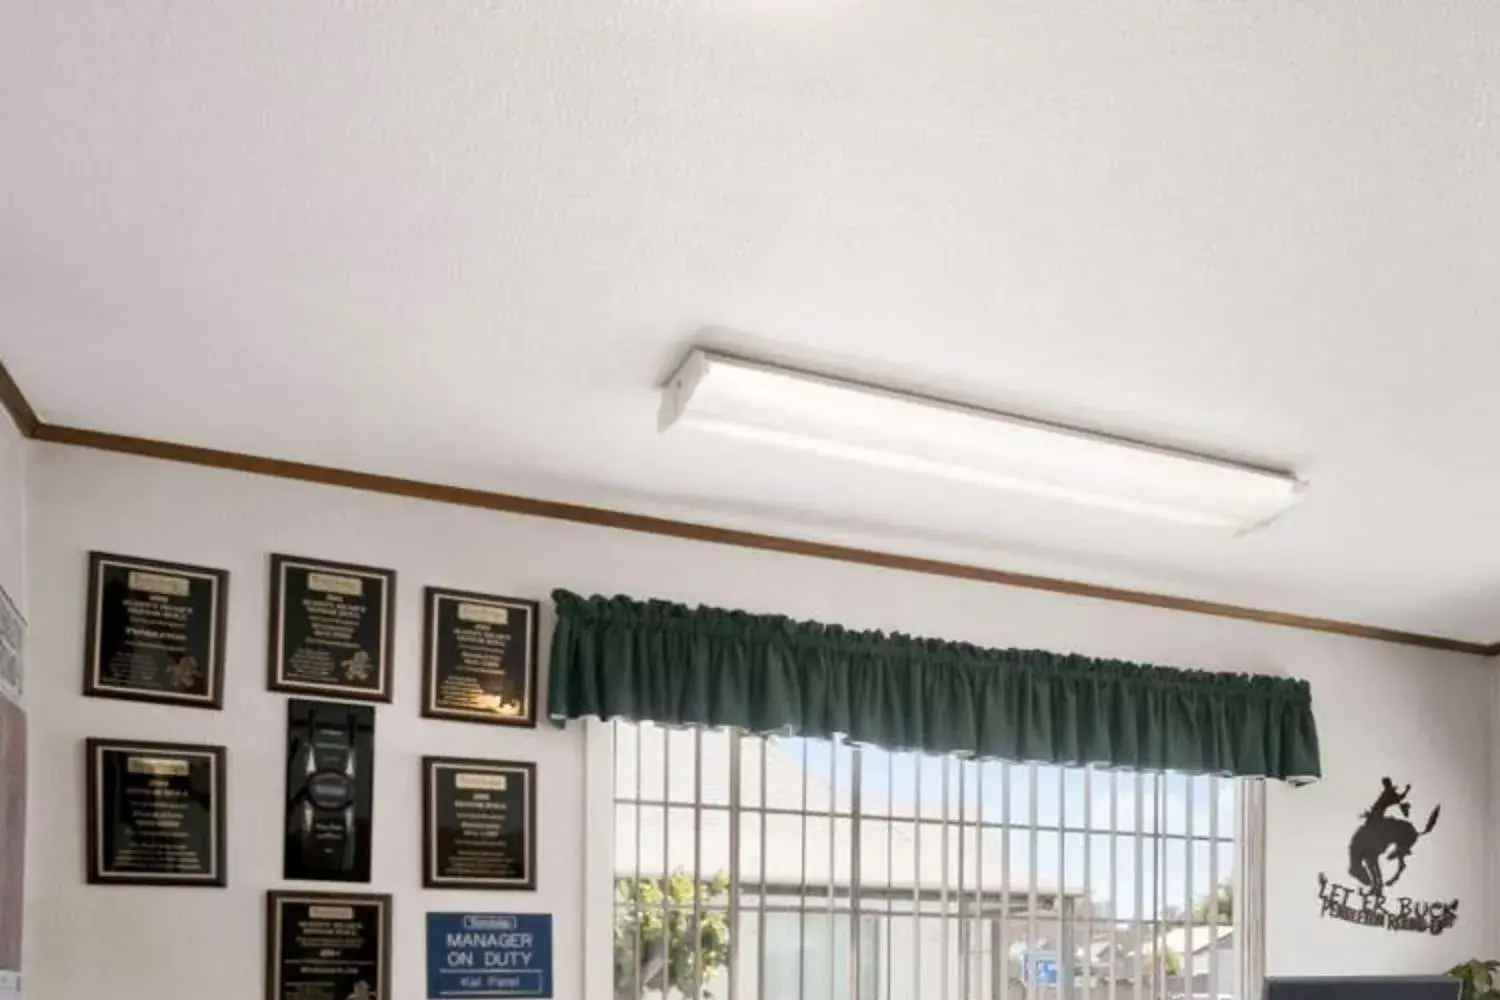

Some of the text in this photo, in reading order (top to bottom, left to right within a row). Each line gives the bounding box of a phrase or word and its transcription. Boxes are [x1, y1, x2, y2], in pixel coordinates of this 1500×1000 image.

[1397, 897, 1459, 920] BUCK
[446, 932, 533, 948] MANAGER
[447, 951, 532, 967] ON DUTY
